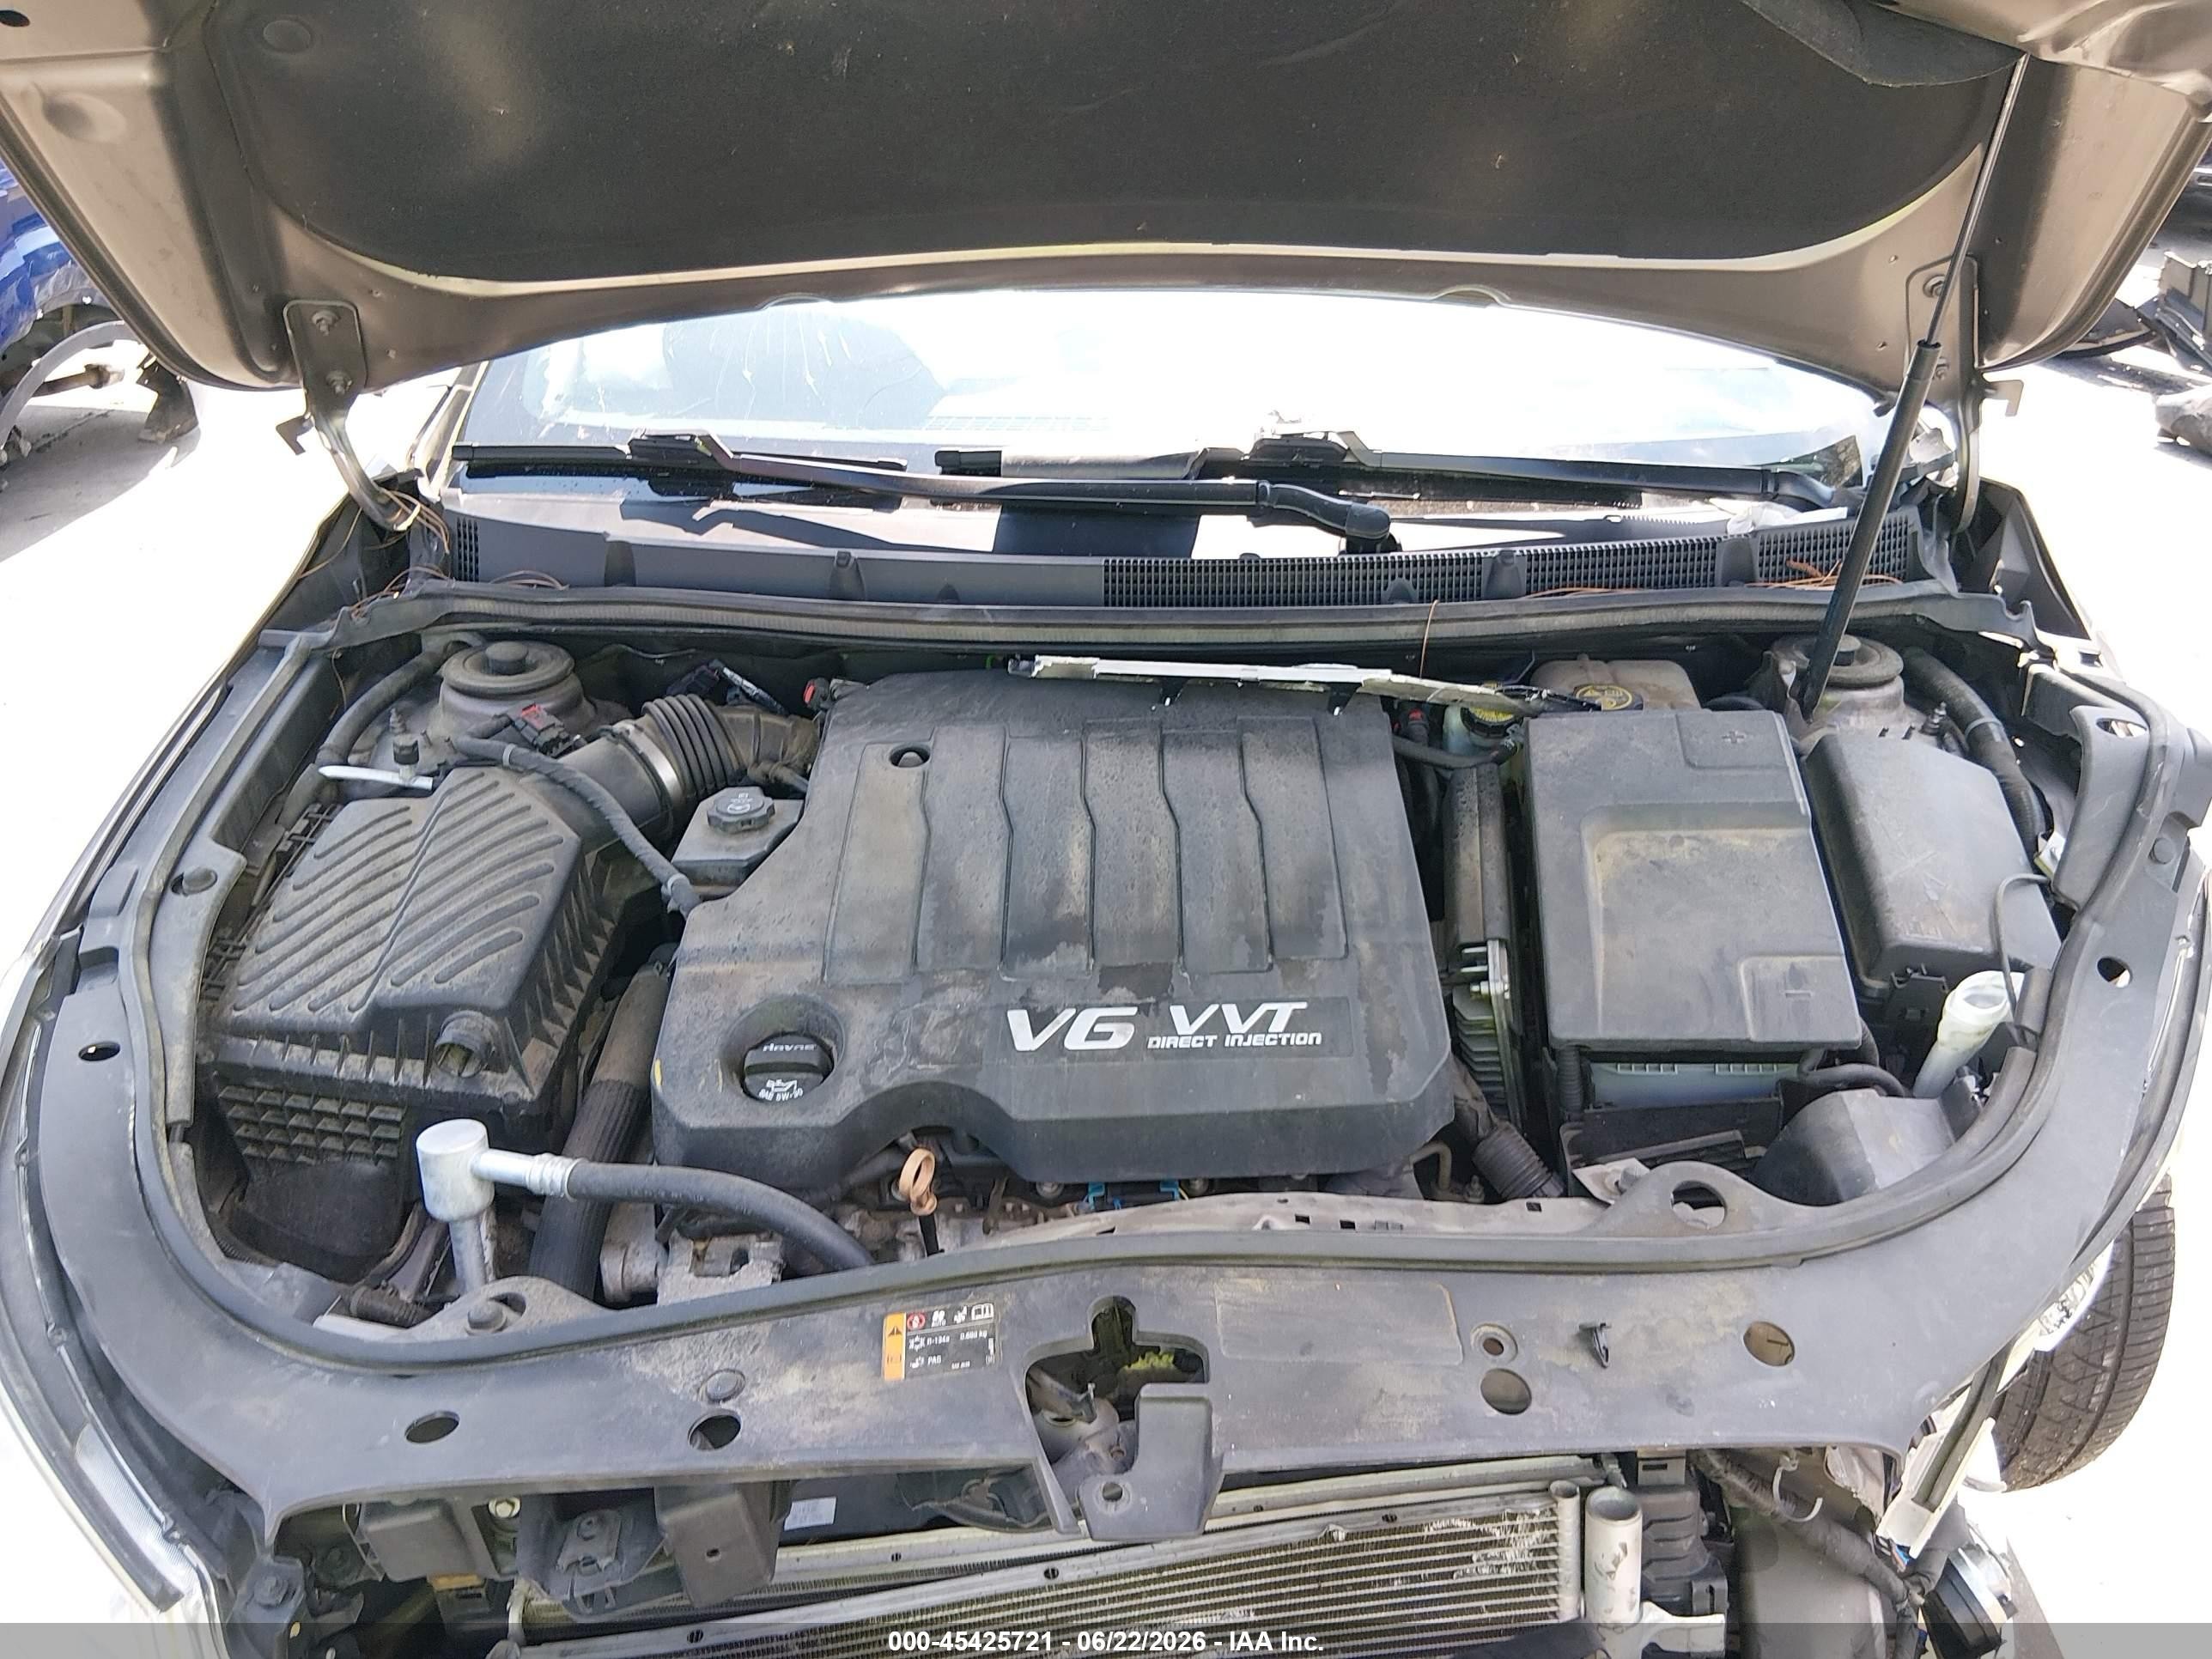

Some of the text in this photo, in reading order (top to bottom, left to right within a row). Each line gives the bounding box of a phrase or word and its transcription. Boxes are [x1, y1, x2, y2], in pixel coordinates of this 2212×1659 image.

[1007, 1001, 1308, 1051] V6 VVT
[1147, 1032, 1322, 1048] DIRECT INJECTION
